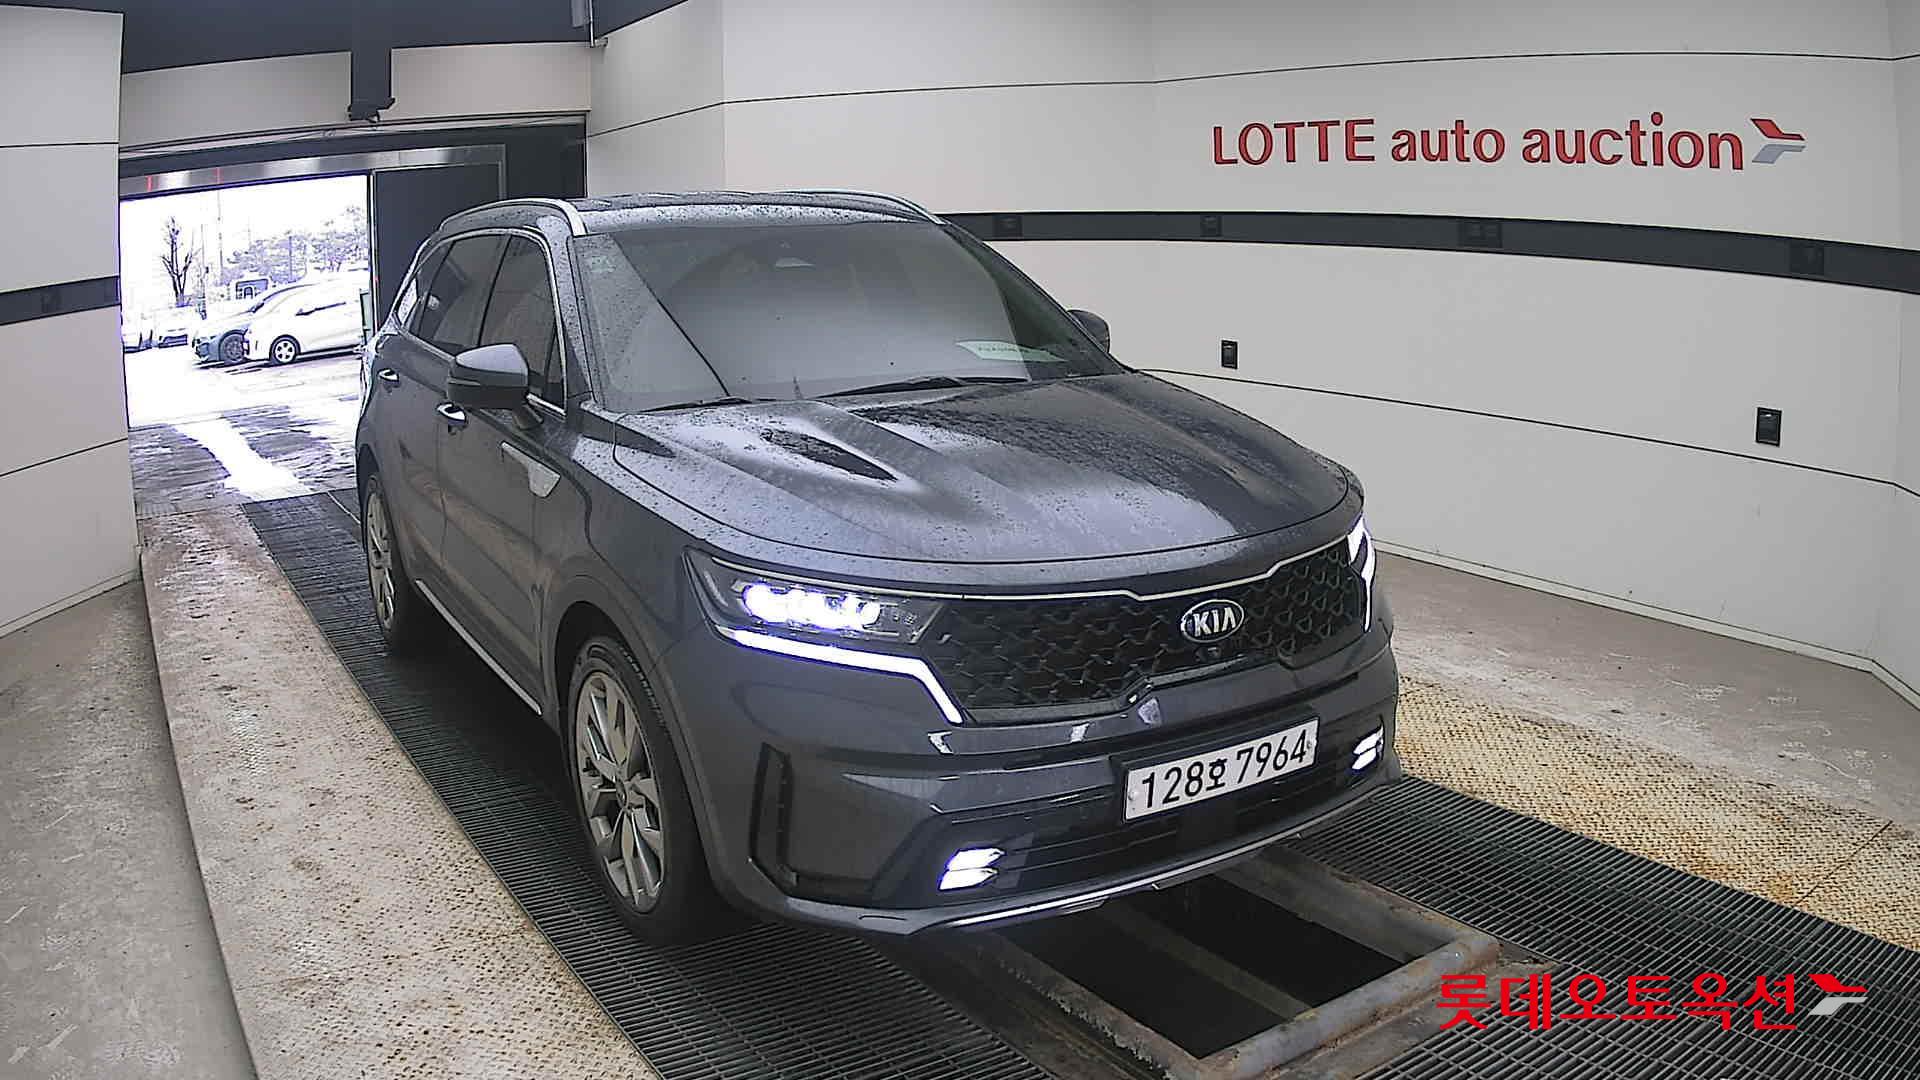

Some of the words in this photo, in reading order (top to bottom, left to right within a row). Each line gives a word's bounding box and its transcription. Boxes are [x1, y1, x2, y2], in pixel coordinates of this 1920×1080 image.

[1213, 118, 1375, 165] LOTTE
[1391, 119, 1505, 163] auto
[1522, 112, 1744, 170] auction
[1193, 607, 1236, 637] KIA
[1236, 729, 1307, 784] 7964
